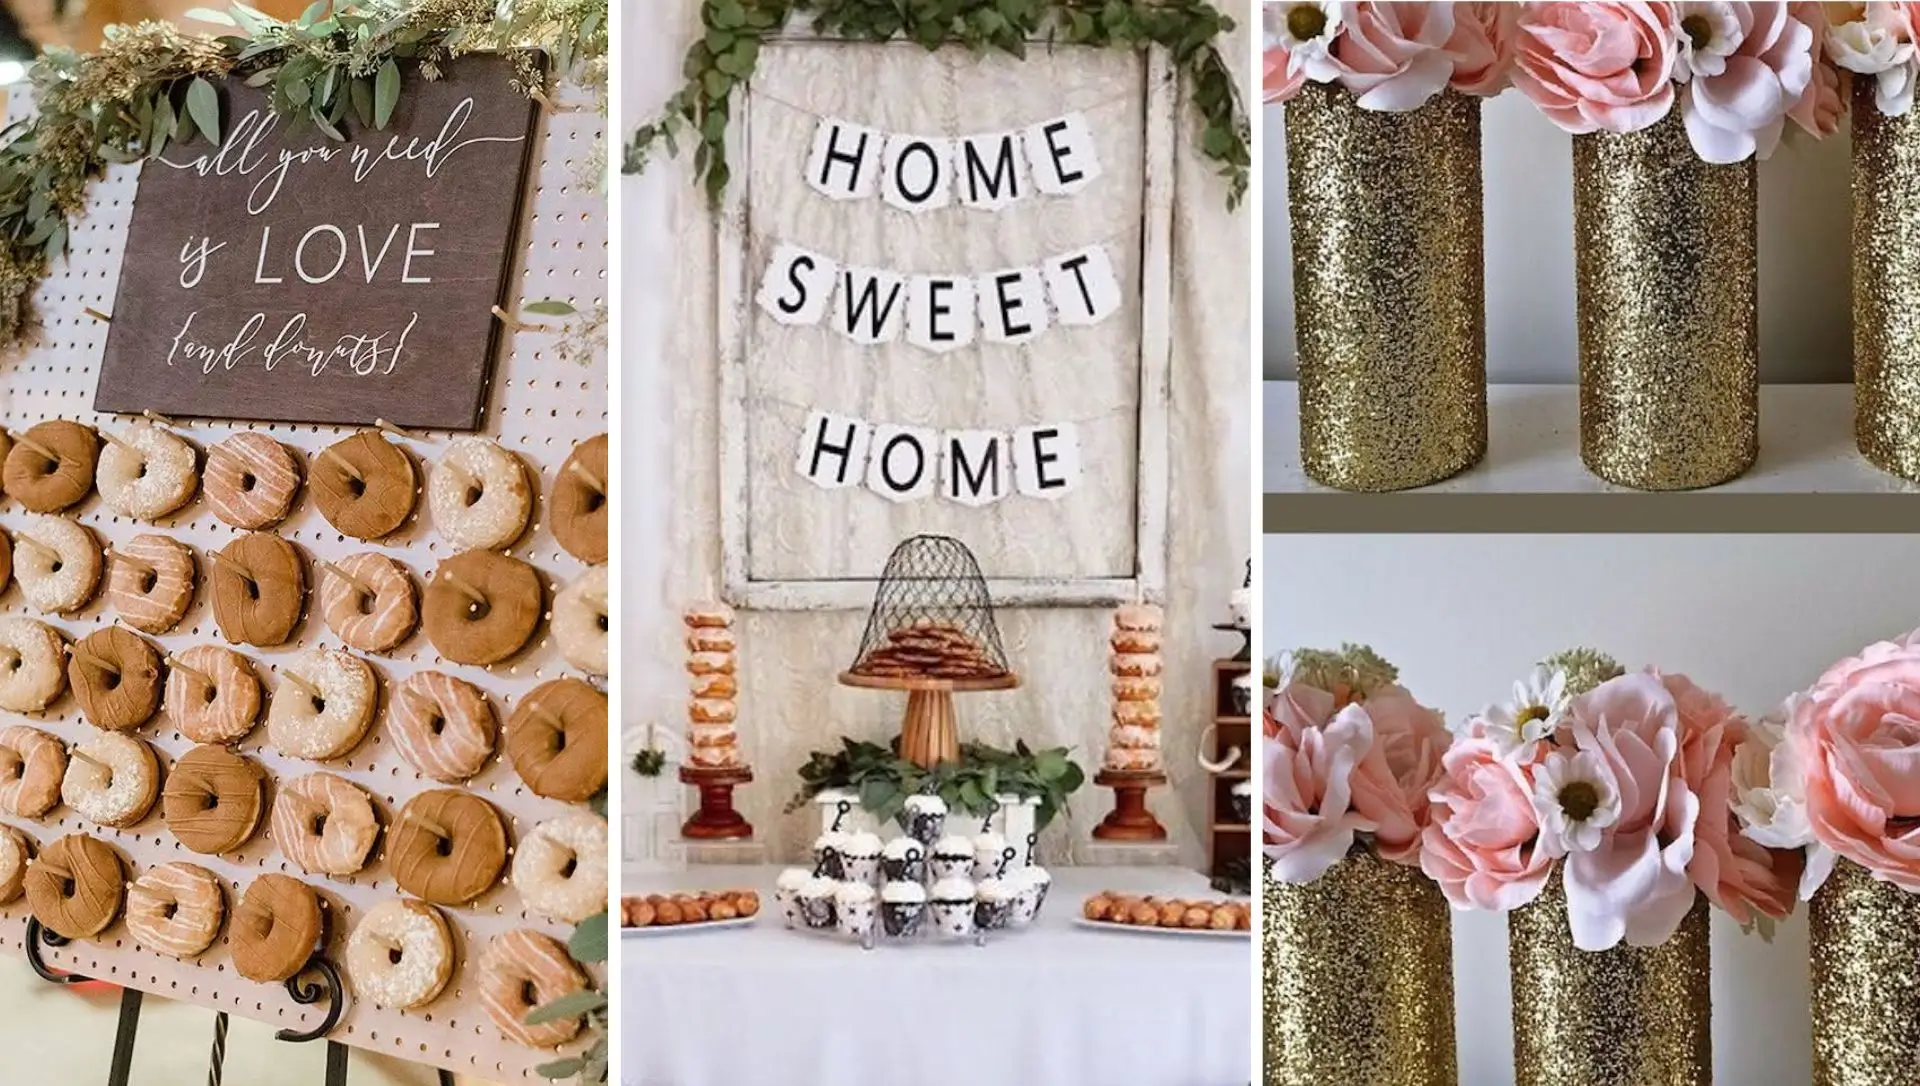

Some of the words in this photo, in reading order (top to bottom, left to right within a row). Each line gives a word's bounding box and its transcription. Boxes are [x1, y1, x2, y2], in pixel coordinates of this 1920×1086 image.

[160, 109, 280, 177] all
[247, 145, 342, 215] you
[350, 97, 525, 183] need
[820, 120, 1083, 203] HOME
[179, 234, 227, 289] is
[254, 222, 441, 286] LOVE
[777, 255, 1096, 341] SWEET
[808, 416, 1066, 499] HOME
